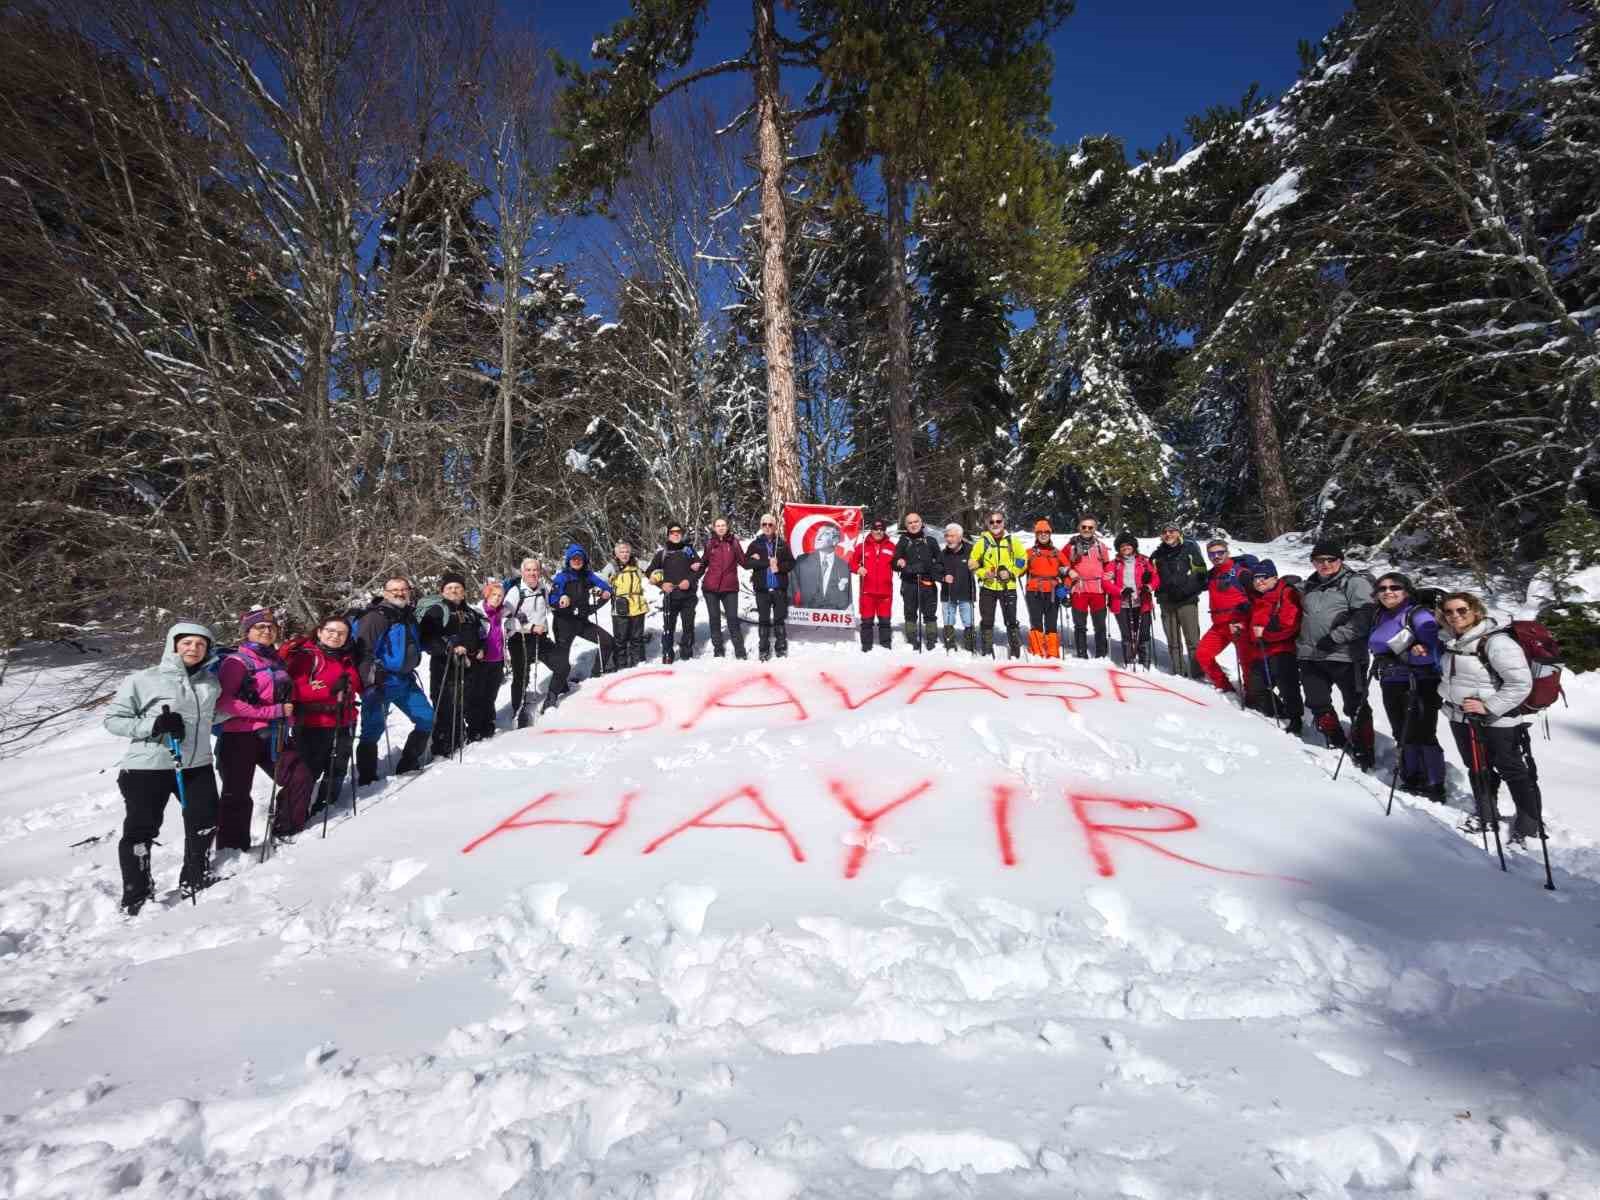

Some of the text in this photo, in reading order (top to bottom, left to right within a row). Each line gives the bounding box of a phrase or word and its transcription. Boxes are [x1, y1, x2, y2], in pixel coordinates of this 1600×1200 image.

[812, 612, 852, 625] BARIŞ
[542, 663, 1209, 735] SAVAŞA
[460, 776, 1308, 882] HAYIR
